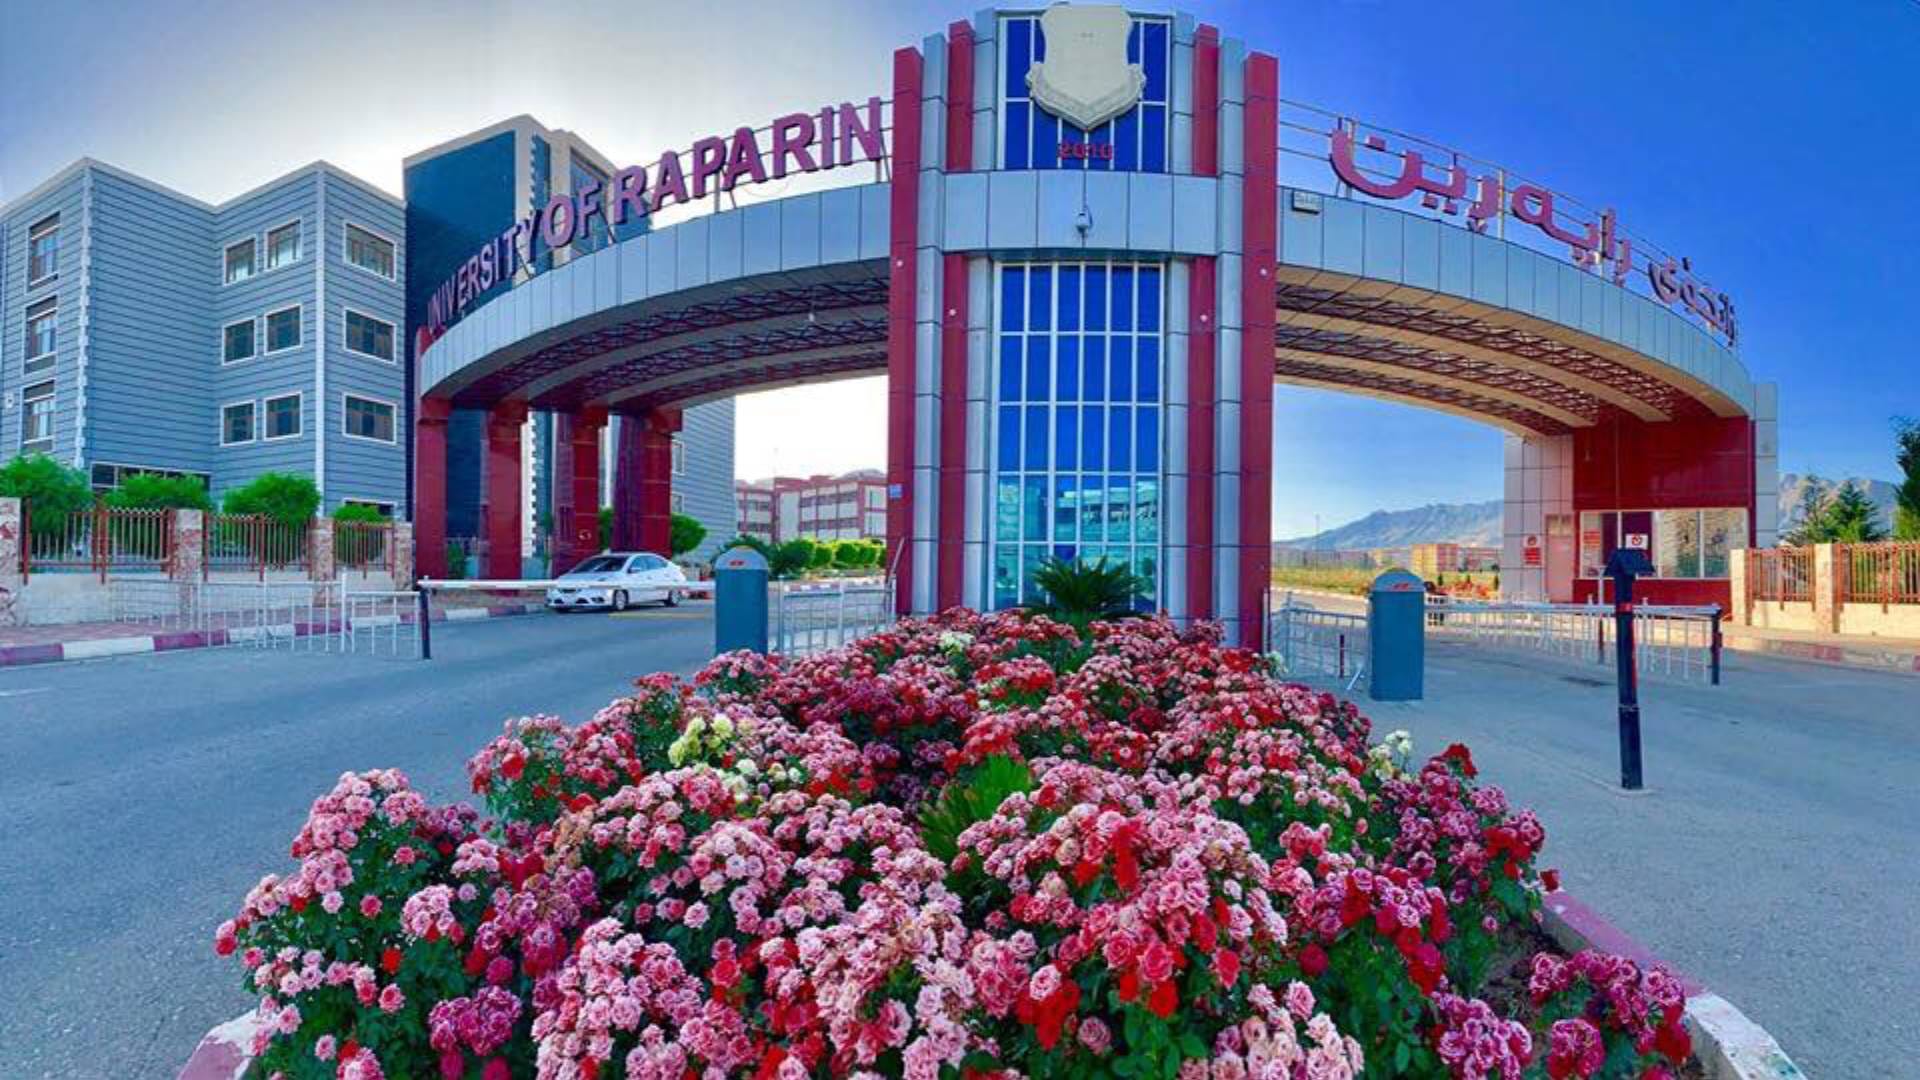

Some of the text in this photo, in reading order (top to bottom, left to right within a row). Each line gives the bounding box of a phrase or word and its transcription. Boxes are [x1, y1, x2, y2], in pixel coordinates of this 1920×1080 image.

[541, 178, 604, 249] OF
[612, 96, 882, 225] RAPARIN
[1058, 141, 1113, 160] 2010
